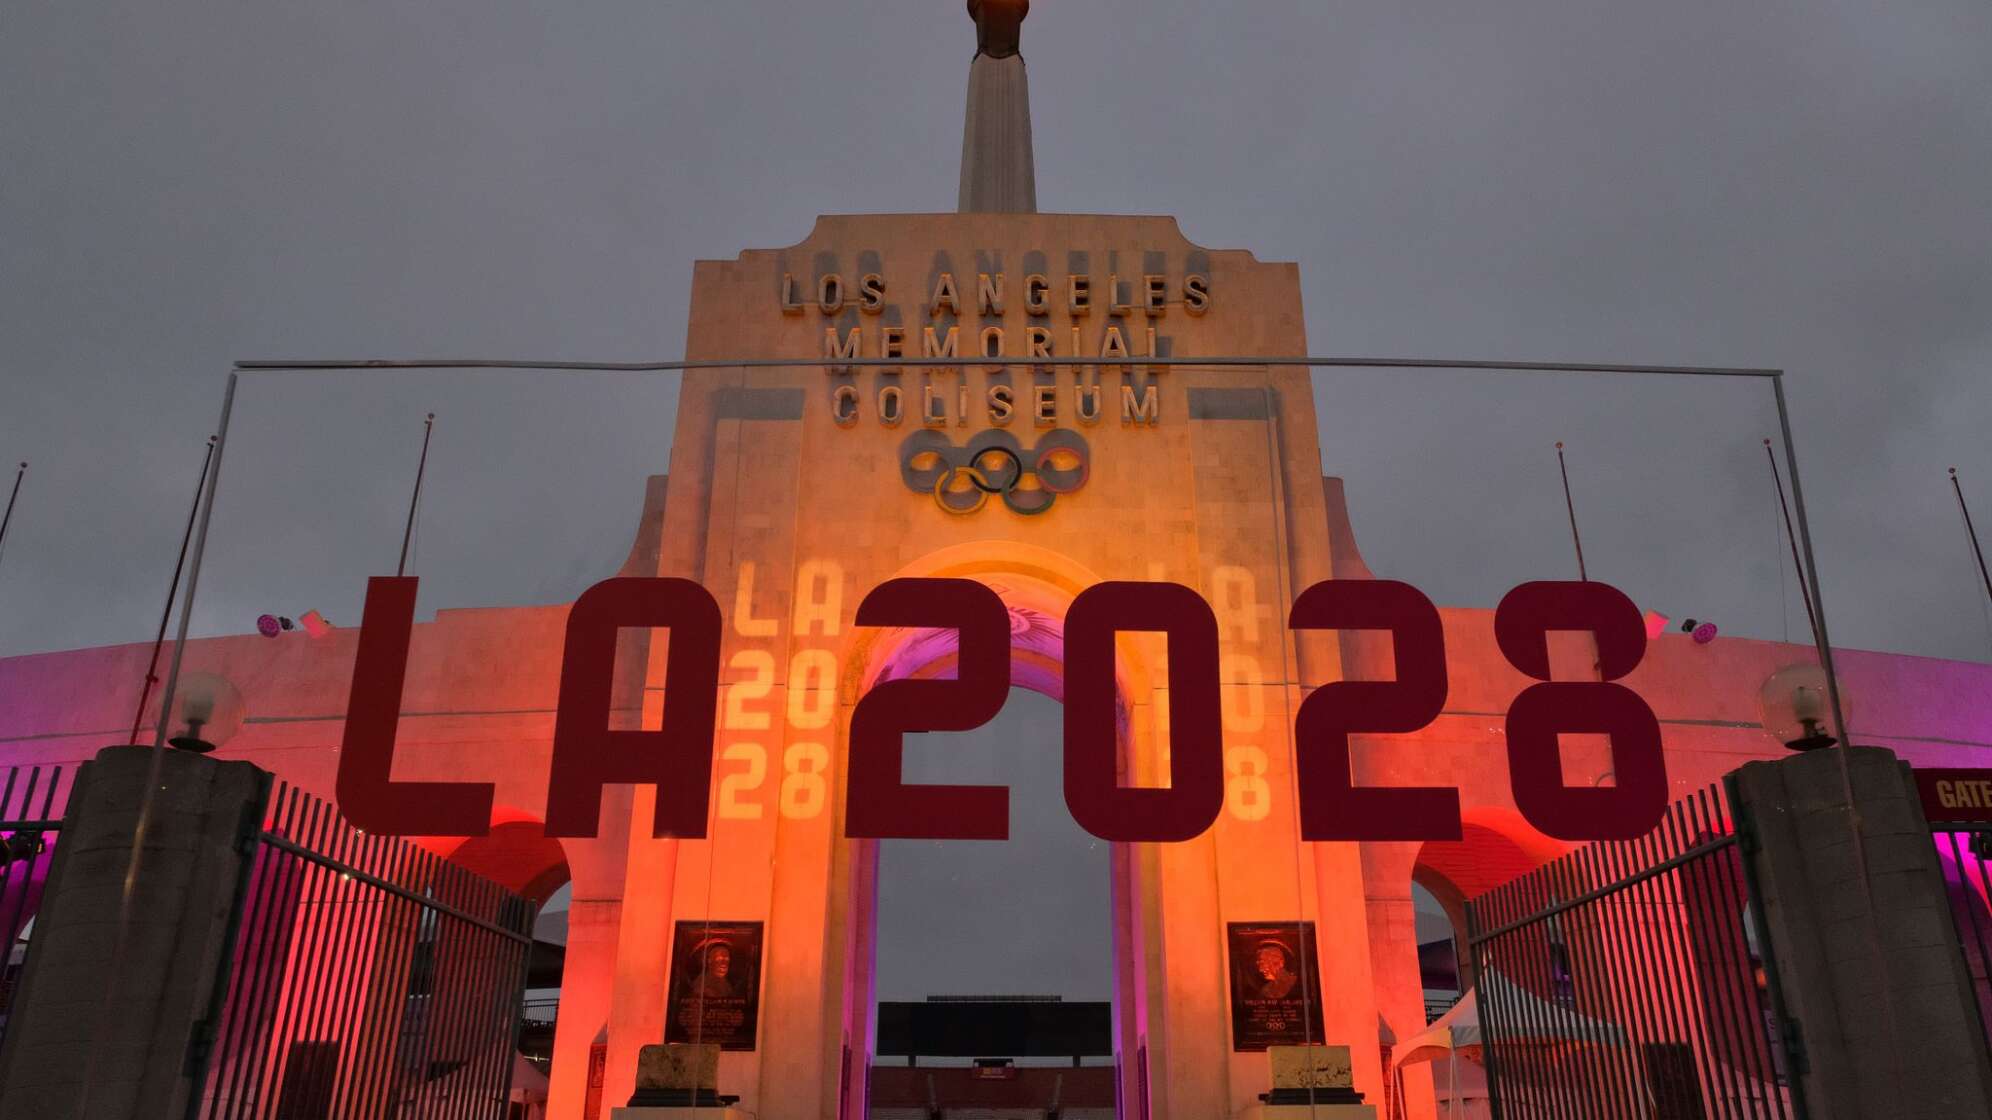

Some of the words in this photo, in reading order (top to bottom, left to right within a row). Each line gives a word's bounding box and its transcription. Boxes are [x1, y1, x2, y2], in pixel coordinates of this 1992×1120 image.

[783, 272, 884, 316] LOS
[929, 272, 1211, 317] ANGELES
[824, 326, 1170, 375] MEMORIAL
[832, 385, 1160, 428] COLISEUM
[735, 560, 843, 636] LA
[337, 577, 721, 839] LA
[846, 579, 1669, 842] 2028
[725, 649, 837, 730] 20
[719, 742, 829, 820] 28
[1936, 780, 1992, 808] GATE
